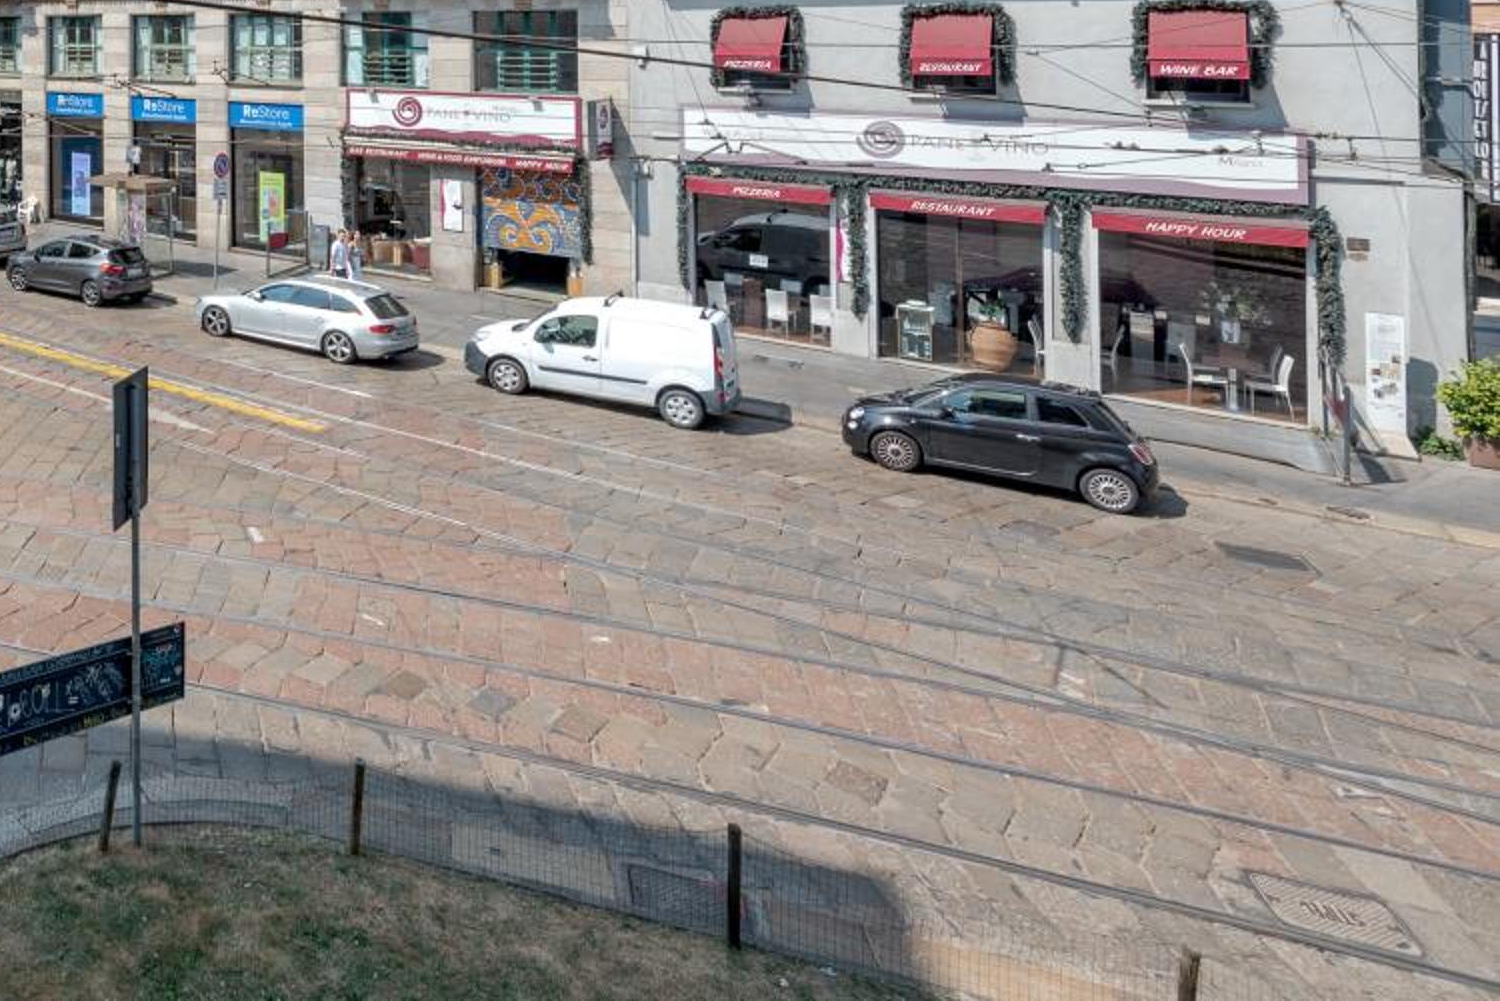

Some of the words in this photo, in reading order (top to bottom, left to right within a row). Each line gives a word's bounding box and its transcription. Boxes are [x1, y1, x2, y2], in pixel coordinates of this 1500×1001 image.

[723, 59, 772, 71] PIZZERIA
[919, 61, 983, 73] RESTAURANT
[1160, 64, 1200, 76] WINE
[1204, 65, 1239, 77] BAR
[143, 98, 185, 114] ReStore
[242, 103, 290, 119] ReStore
[732, 185, 781, 199] PIZZERIA
[910, 200, 997, 217] RESTAURANT
[1145, 221, 1198, 237] HAPPY
[1201, 226, 1248, 241] HOUR
